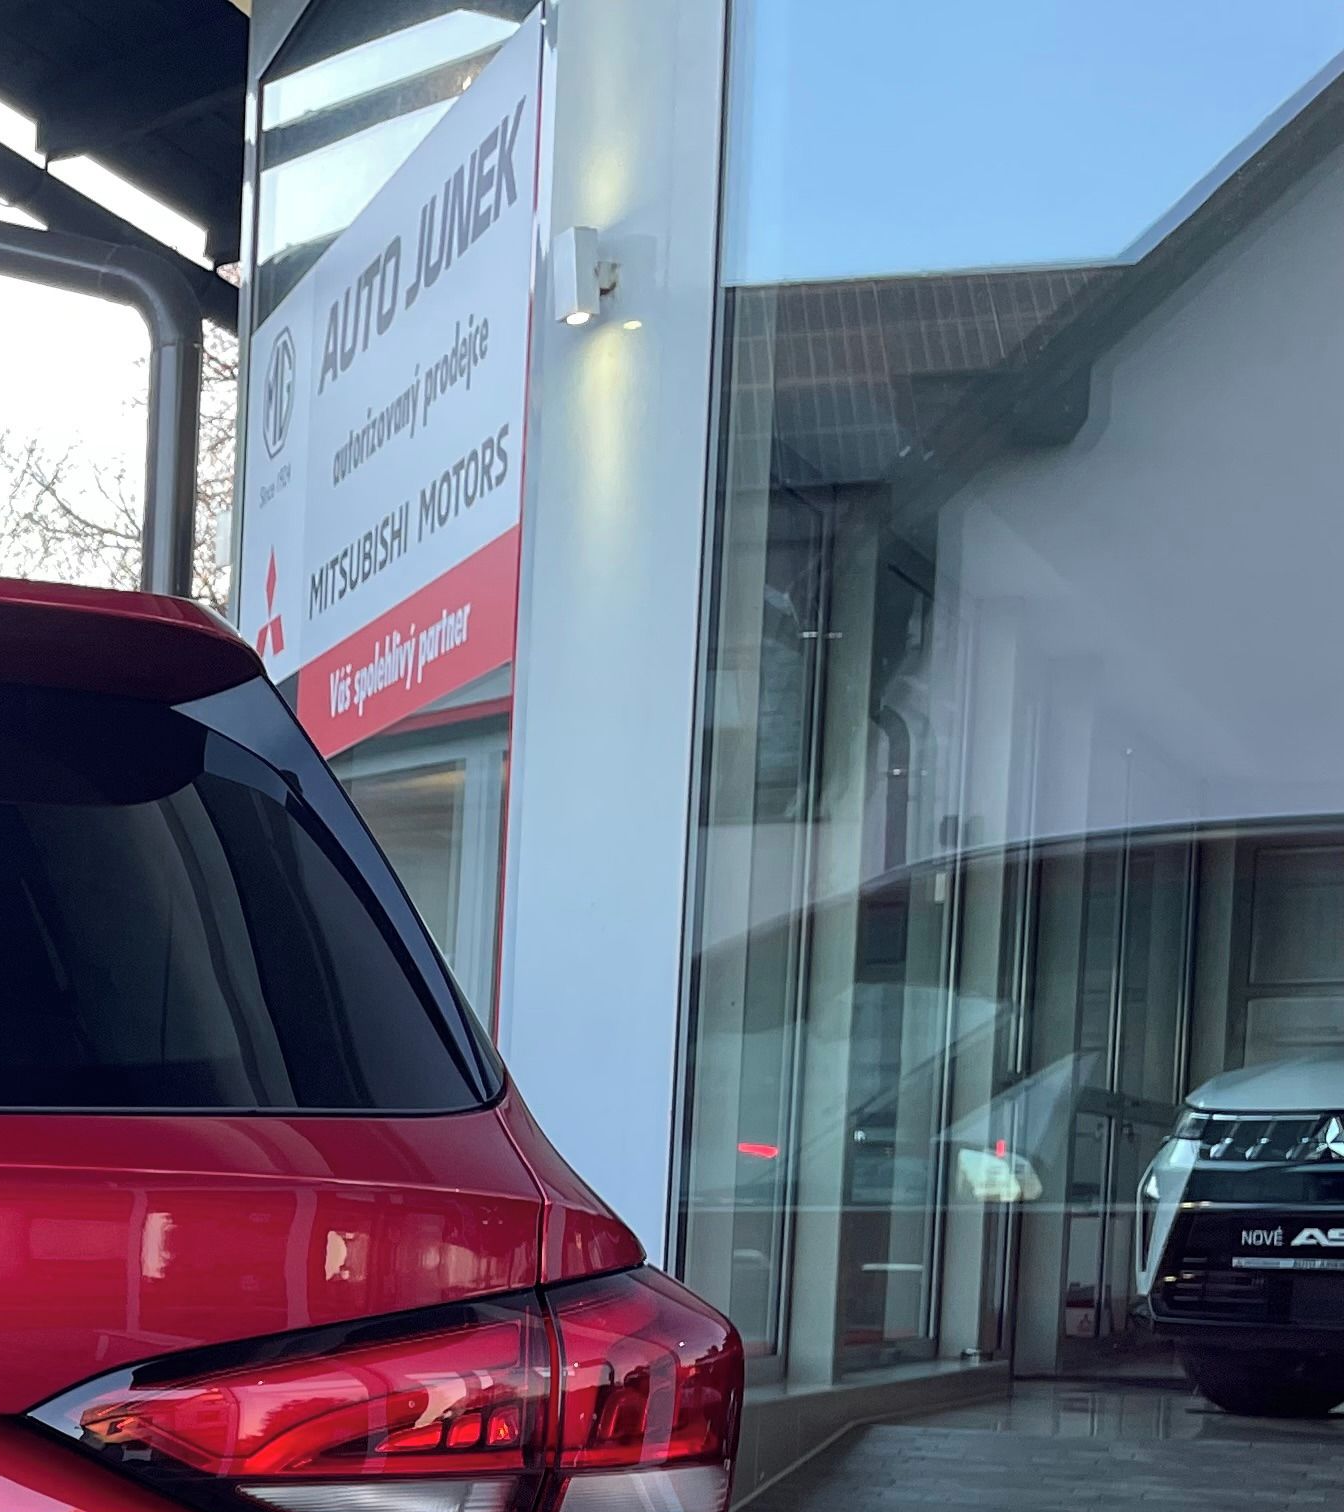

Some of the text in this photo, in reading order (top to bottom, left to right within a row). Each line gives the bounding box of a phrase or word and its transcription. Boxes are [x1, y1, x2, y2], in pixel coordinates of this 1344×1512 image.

[318, 95, 526, 396] AUTO JUNEK
[265, 337, 293, 447] MG
[333, 314, 489, 488] autorizovaný prodejce
[308, 423, 510, 621] MITSUBISHI MOTORS
[330, 603, 471, 718] Váš spolehlivý partner
[1241, 1225, 1283, 1247] NOVÉ
